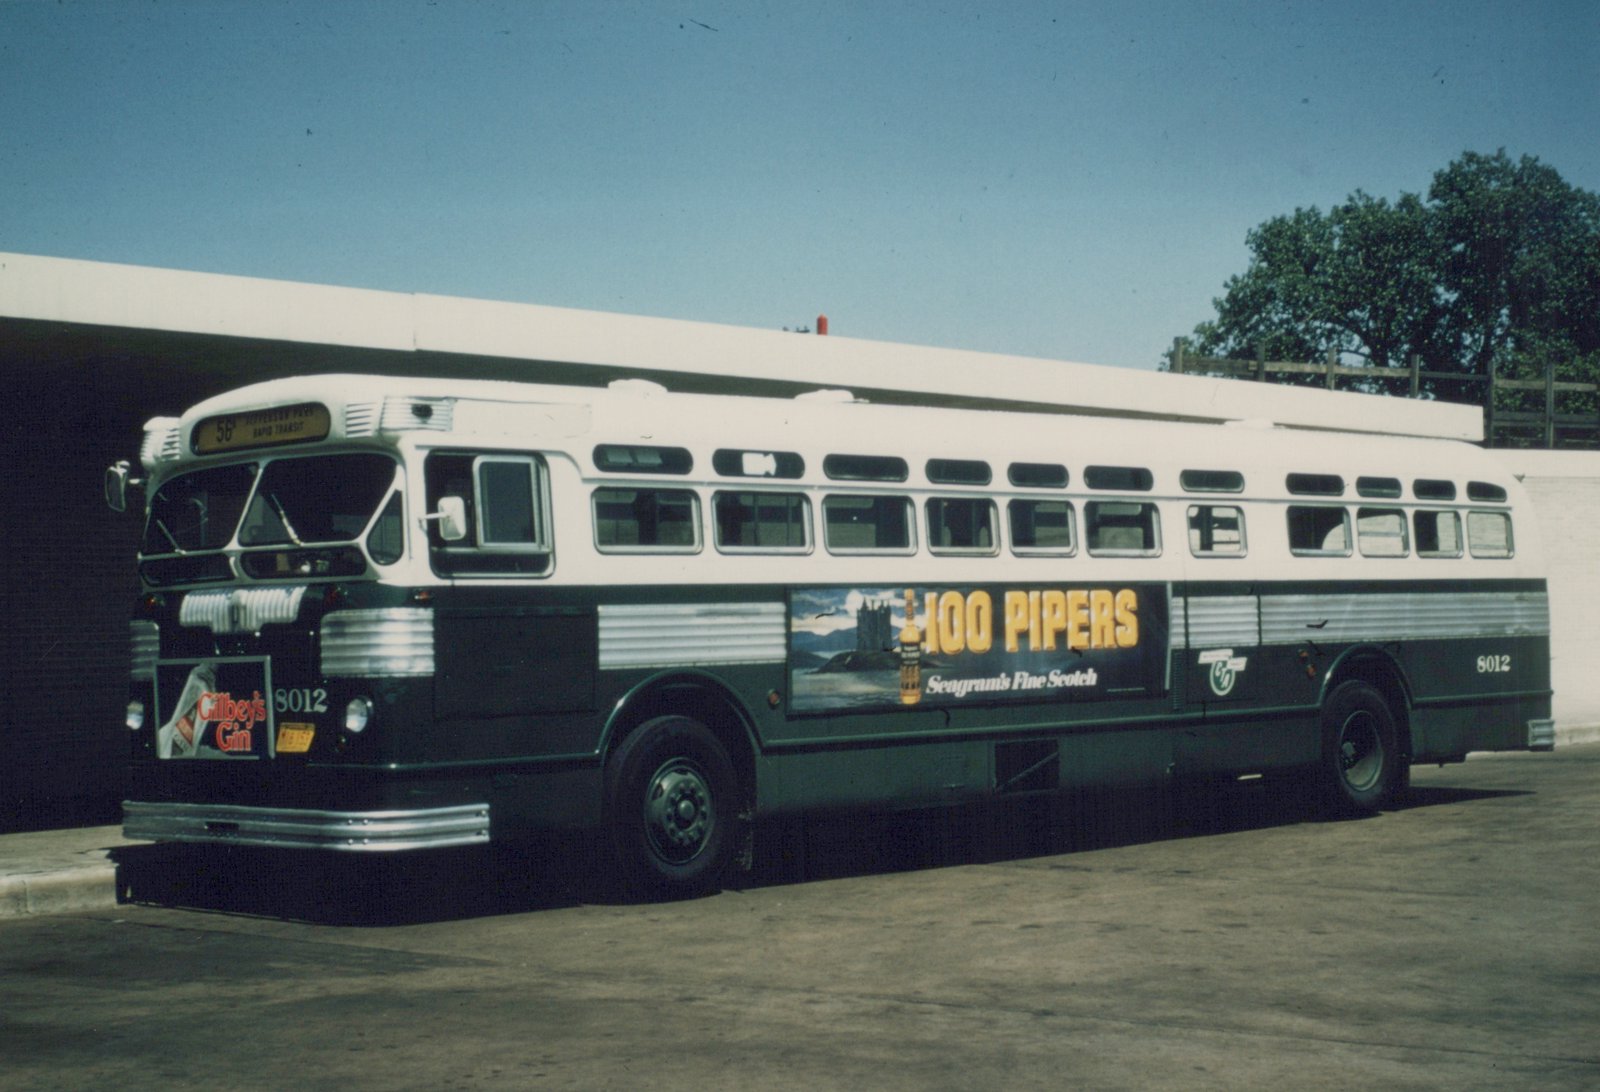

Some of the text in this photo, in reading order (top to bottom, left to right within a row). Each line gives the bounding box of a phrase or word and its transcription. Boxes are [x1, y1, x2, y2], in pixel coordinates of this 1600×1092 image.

[923, 589, 1138, 654] 100 PIPERS
[1477, 655, 1511, 673] 8012
[925, 668, 1098, 697] Seagram's Fine Scotch
[198, 690, 266, 729] Gilbey's
[275, 688, 328, 713] 8012
[216, 721, 251, 751] Gin
